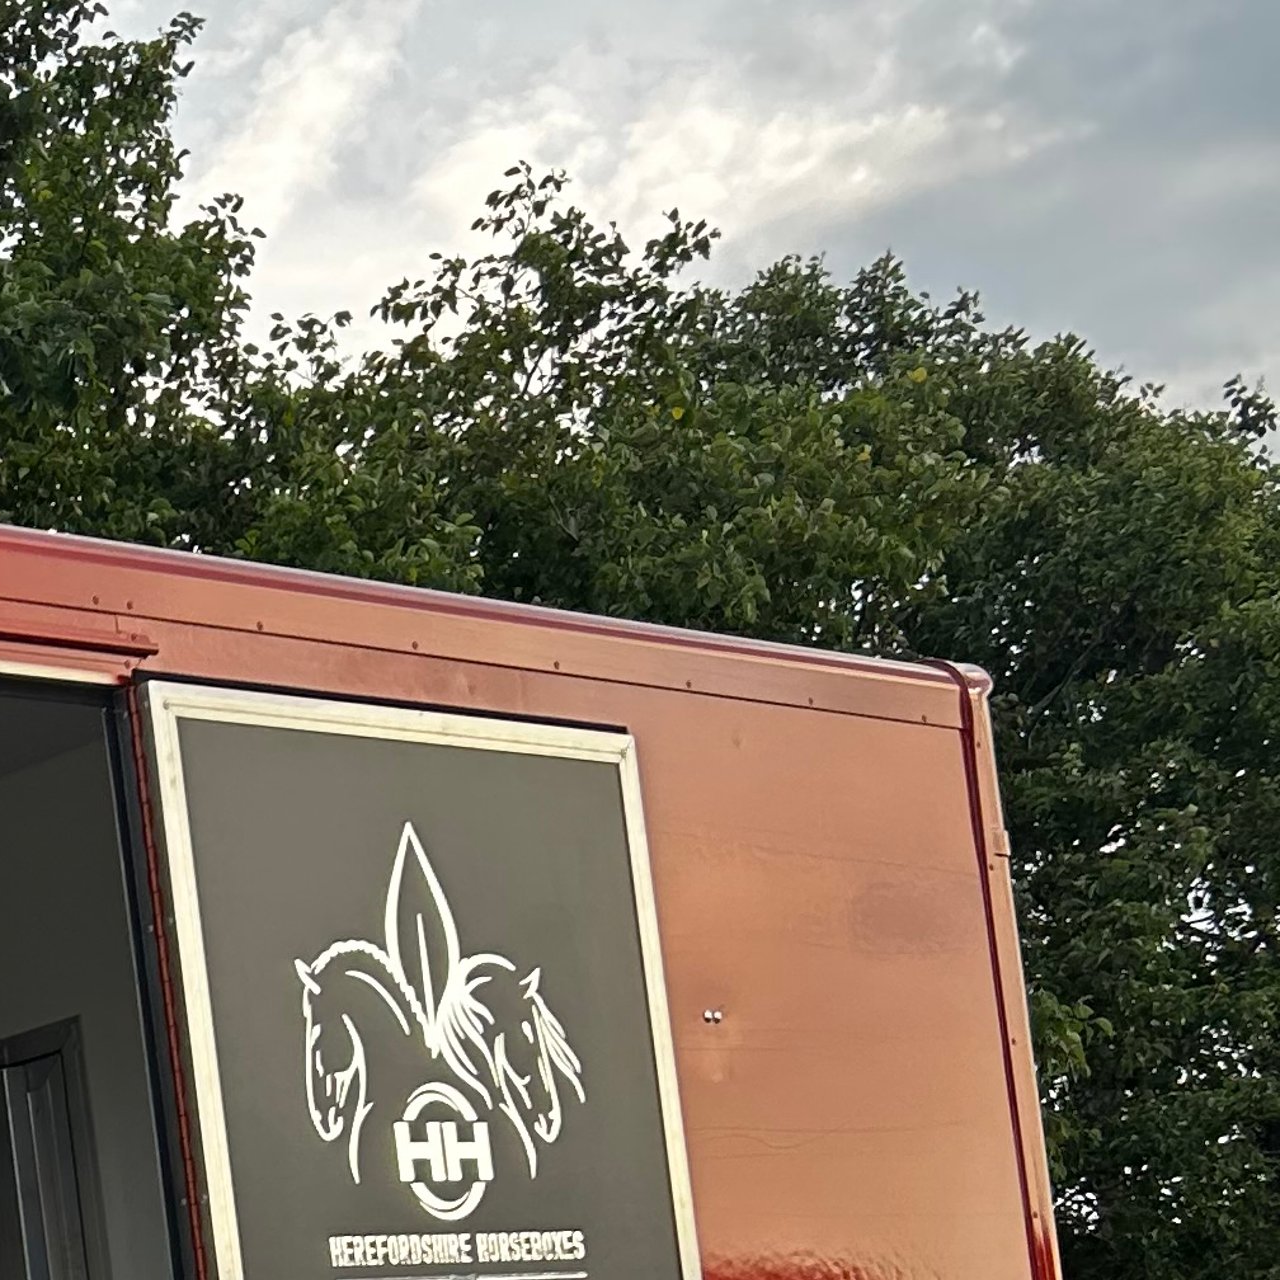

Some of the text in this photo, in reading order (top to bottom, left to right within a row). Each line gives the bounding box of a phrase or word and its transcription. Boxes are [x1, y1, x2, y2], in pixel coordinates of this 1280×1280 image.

[393, 1121, 494, 1182] HH
[329, 1230, 586, 1267] HEREFORDSHIRE HORSEBOXES
